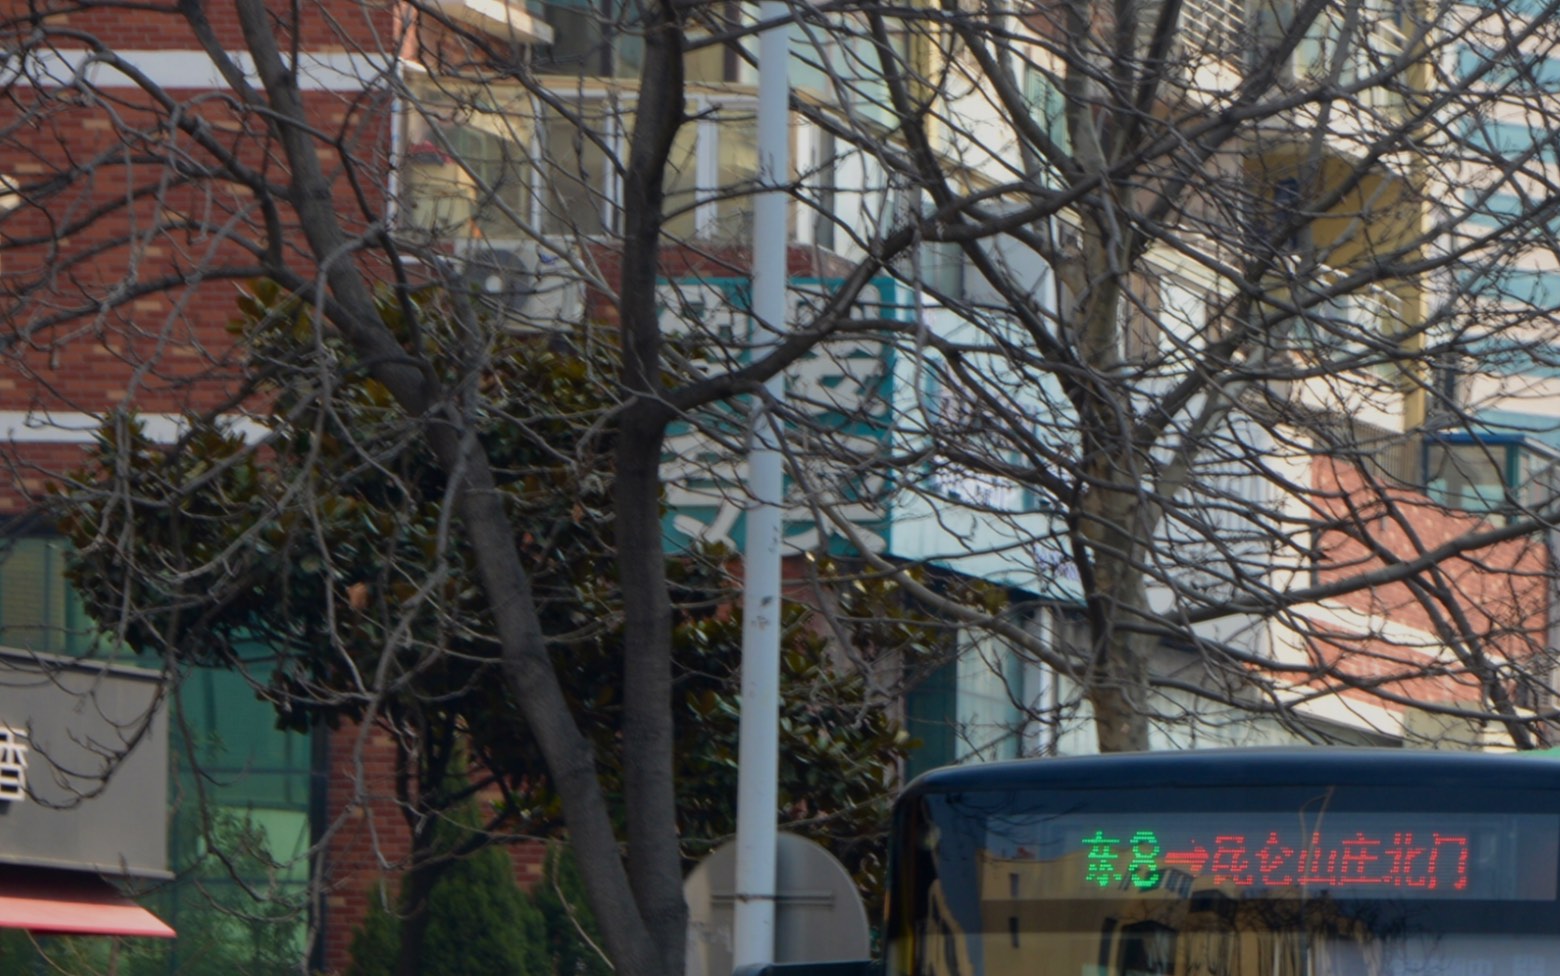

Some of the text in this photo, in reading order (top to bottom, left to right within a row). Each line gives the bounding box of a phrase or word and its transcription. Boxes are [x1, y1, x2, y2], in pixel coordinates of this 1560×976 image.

[1081, 830, 1470, 890] 东8 昆仑山庄北门
